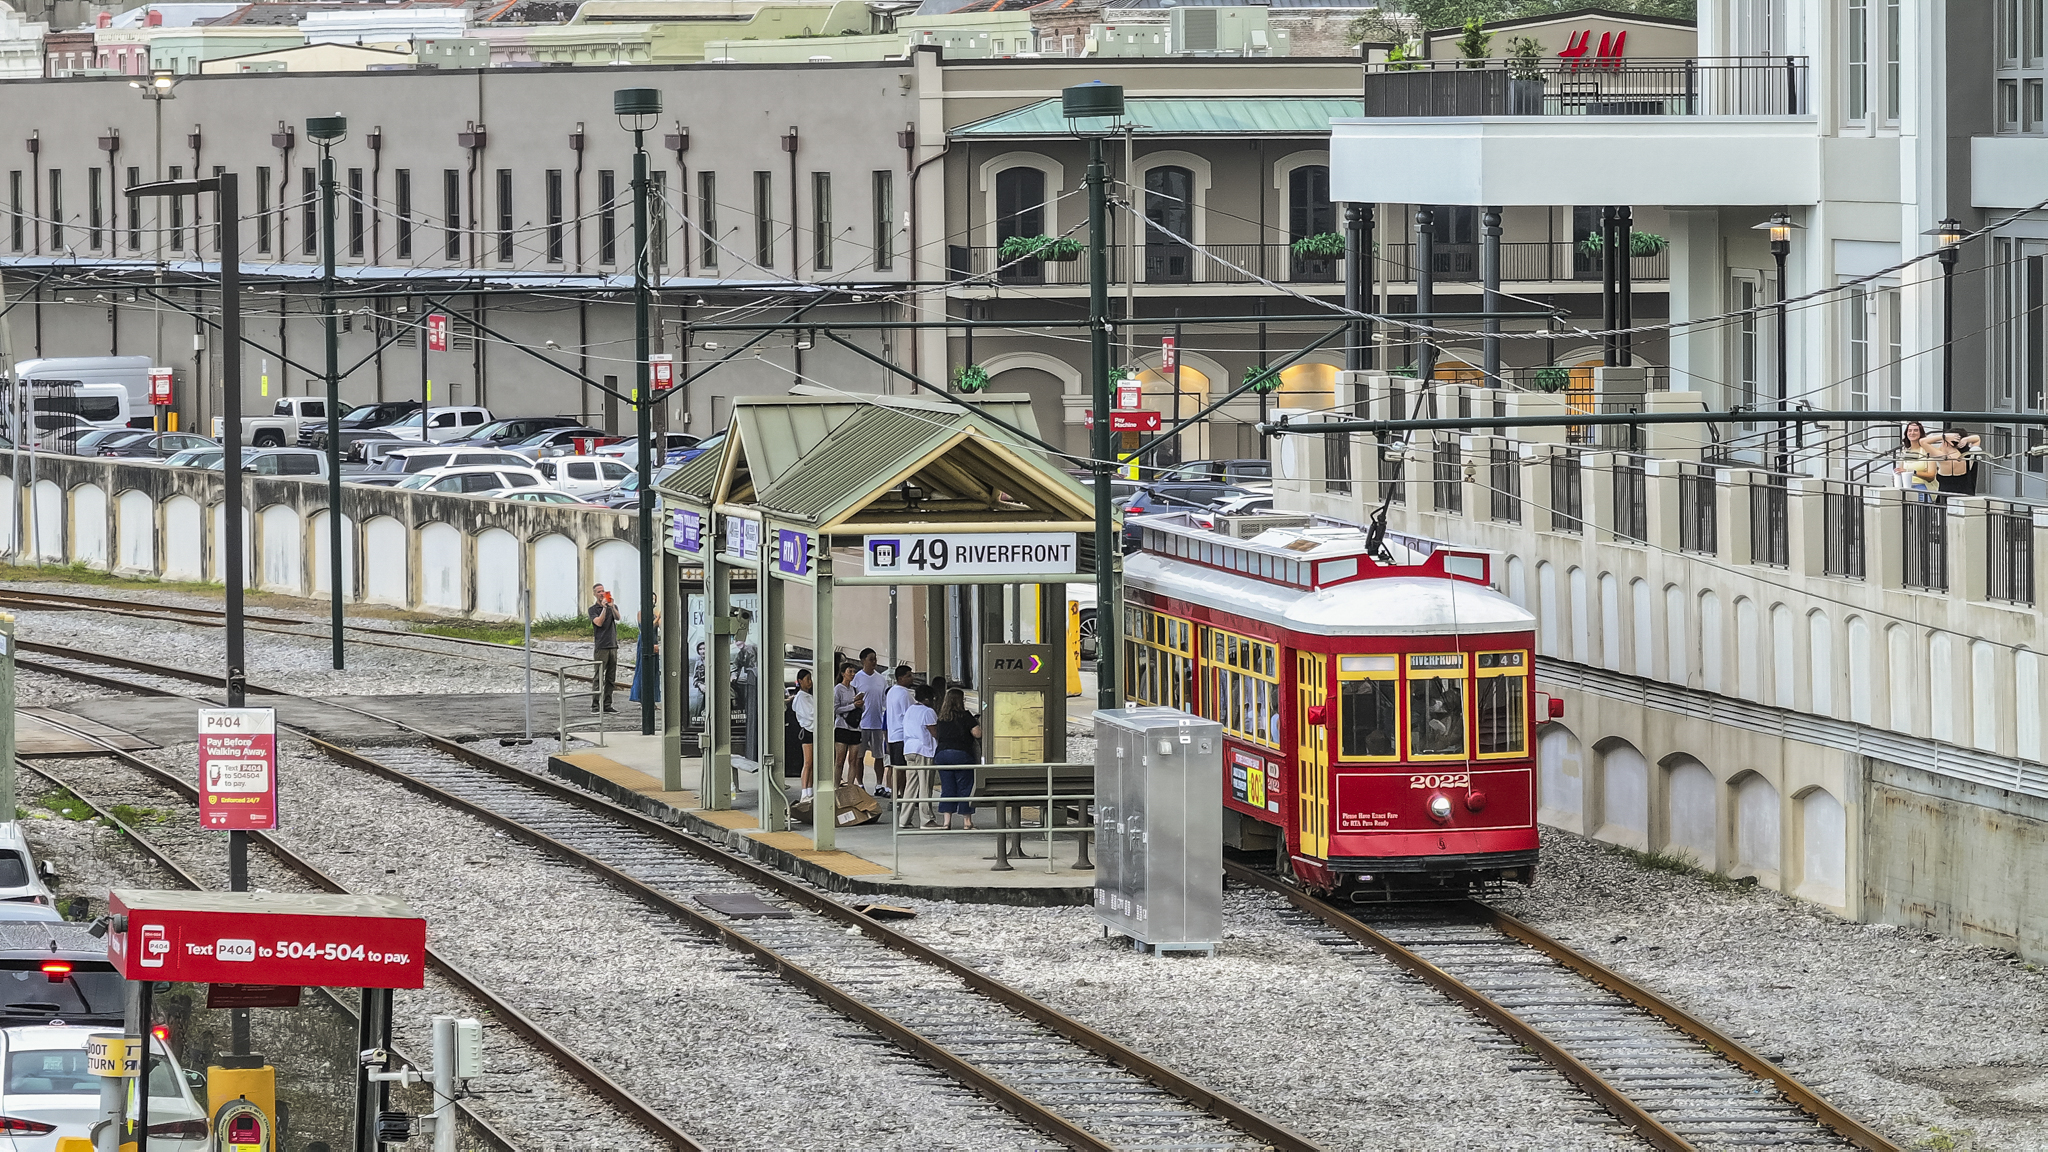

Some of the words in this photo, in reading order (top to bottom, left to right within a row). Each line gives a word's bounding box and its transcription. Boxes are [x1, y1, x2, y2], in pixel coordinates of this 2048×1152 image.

[783, 540, 795, 564] RTA
[907, 538, 949, 571] 49
[955, 544, 1071, 563] RIVERFRONT
[994, 658, 1024, 670] RTA
[207, 716, 241, 728] P404
[207, 738, 223, 747] Pay
[224, 737, 253, 746] Before
[207, 747, 241, 757] Walking
[242, 747, 267, 757] Away.
[1410, 774, 1469, 789] 2022
[185, 943, 213, 955] Text
[219, 945, 252, 955] P404
[258, 946, 273, 957] to
[276, 941, 365, 961] 504-504
[367, 950, 382, 962] to
[384, 952, 410, 965] pay.
[88, 1058, 115, 1070] TURN
